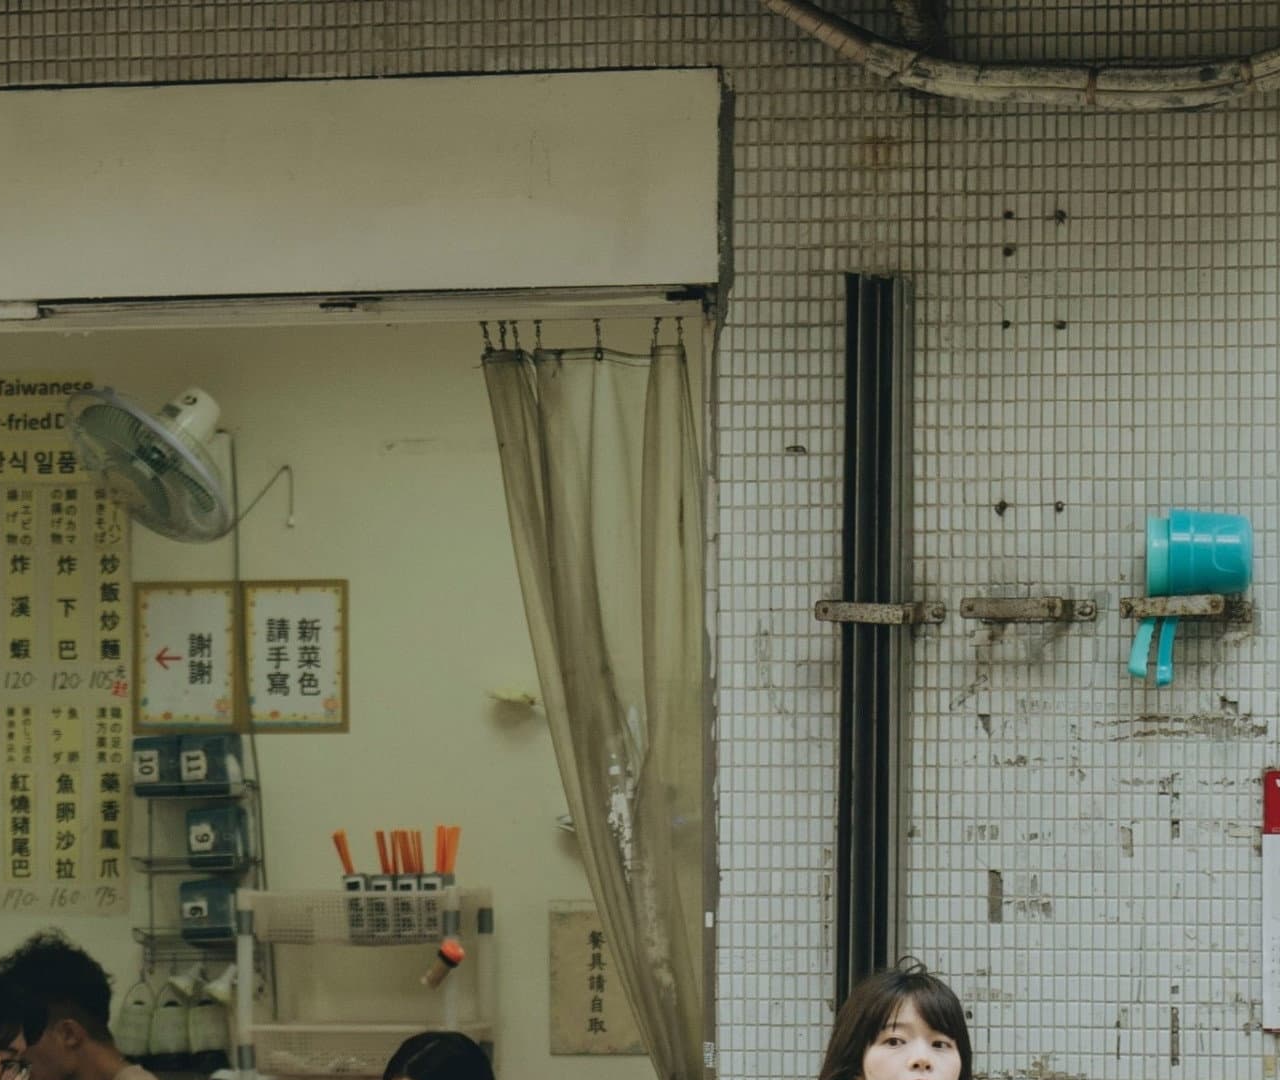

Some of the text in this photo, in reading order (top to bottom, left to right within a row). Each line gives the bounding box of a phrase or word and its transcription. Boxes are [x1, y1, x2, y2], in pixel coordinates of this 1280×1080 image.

[57, 555, 78, 661] 炸下巴
[188, 632, 213, 685] 謝謝
[265, 618, 290, 697] 請手寫
[297, 618, 322, 697] 新菜色
[138, 755, 155, 776] 10
[185, 754, 202, 774] 11
[10, 774, 31, 879] 紅燒豬尾巴
[56, 774, 76, 879] 魚卵沙拉
[587, 930, 608, 1036] 餐具請自取
